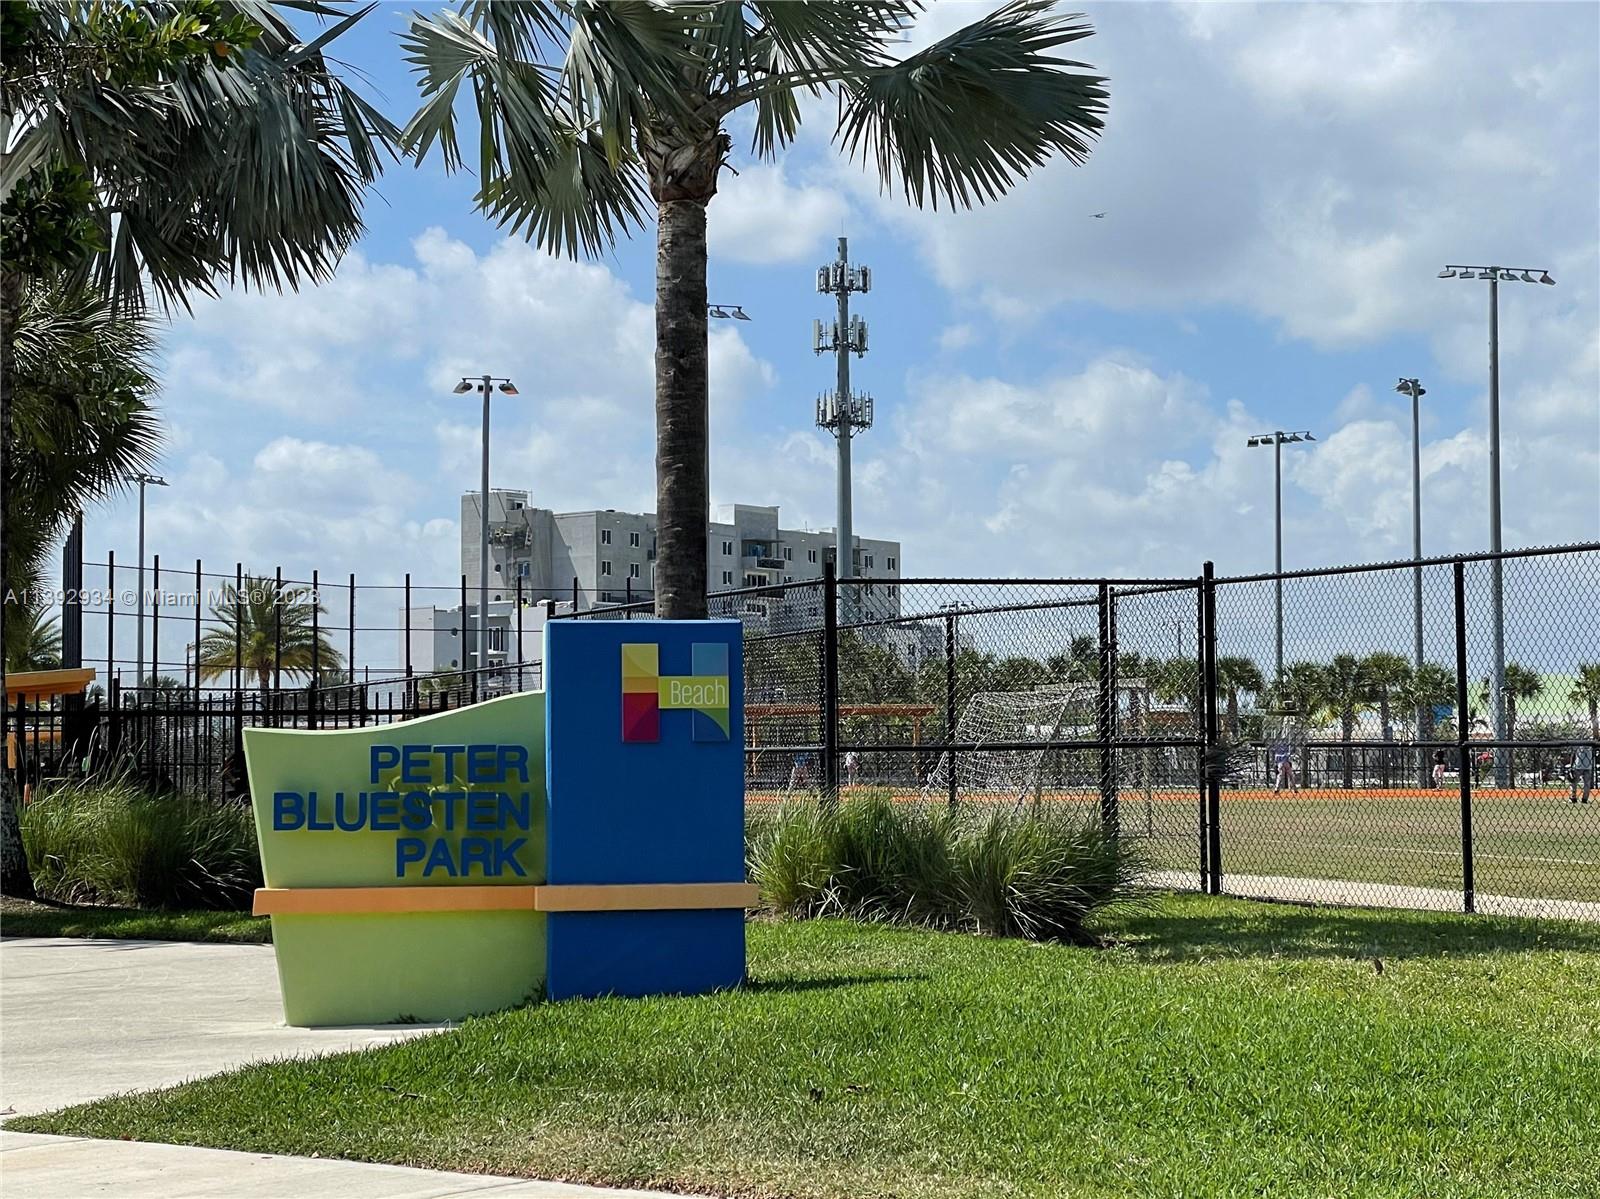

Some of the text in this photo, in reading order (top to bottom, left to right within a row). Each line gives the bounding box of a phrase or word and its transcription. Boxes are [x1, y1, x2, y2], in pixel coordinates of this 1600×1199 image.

[670, 679, 727, 705] Beach
[370, 744, 529, 784] PETER
[273, 791, 530, 832] BLUESTEN
[396, 838, 527, 877] PARK
